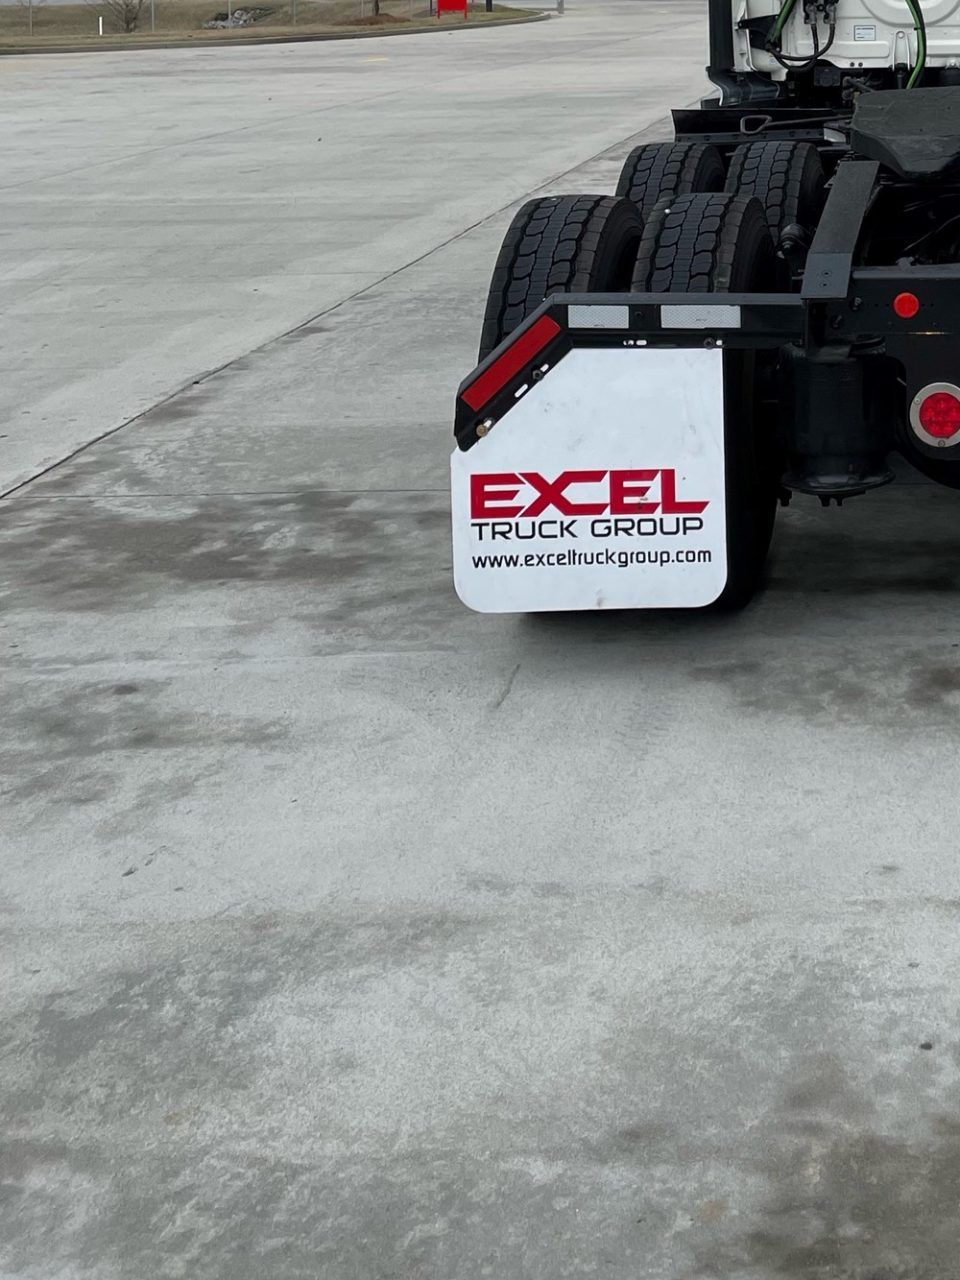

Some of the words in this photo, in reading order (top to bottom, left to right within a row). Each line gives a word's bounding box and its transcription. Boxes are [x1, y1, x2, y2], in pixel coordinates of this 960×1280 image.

[470, 468, 710, 519] EXCEL
[471, 520, 578, 540] TRUCK
[590, 517, 704, 537] GROUP
[472, 548, 712, 568] www.exceltruckgroup.com
